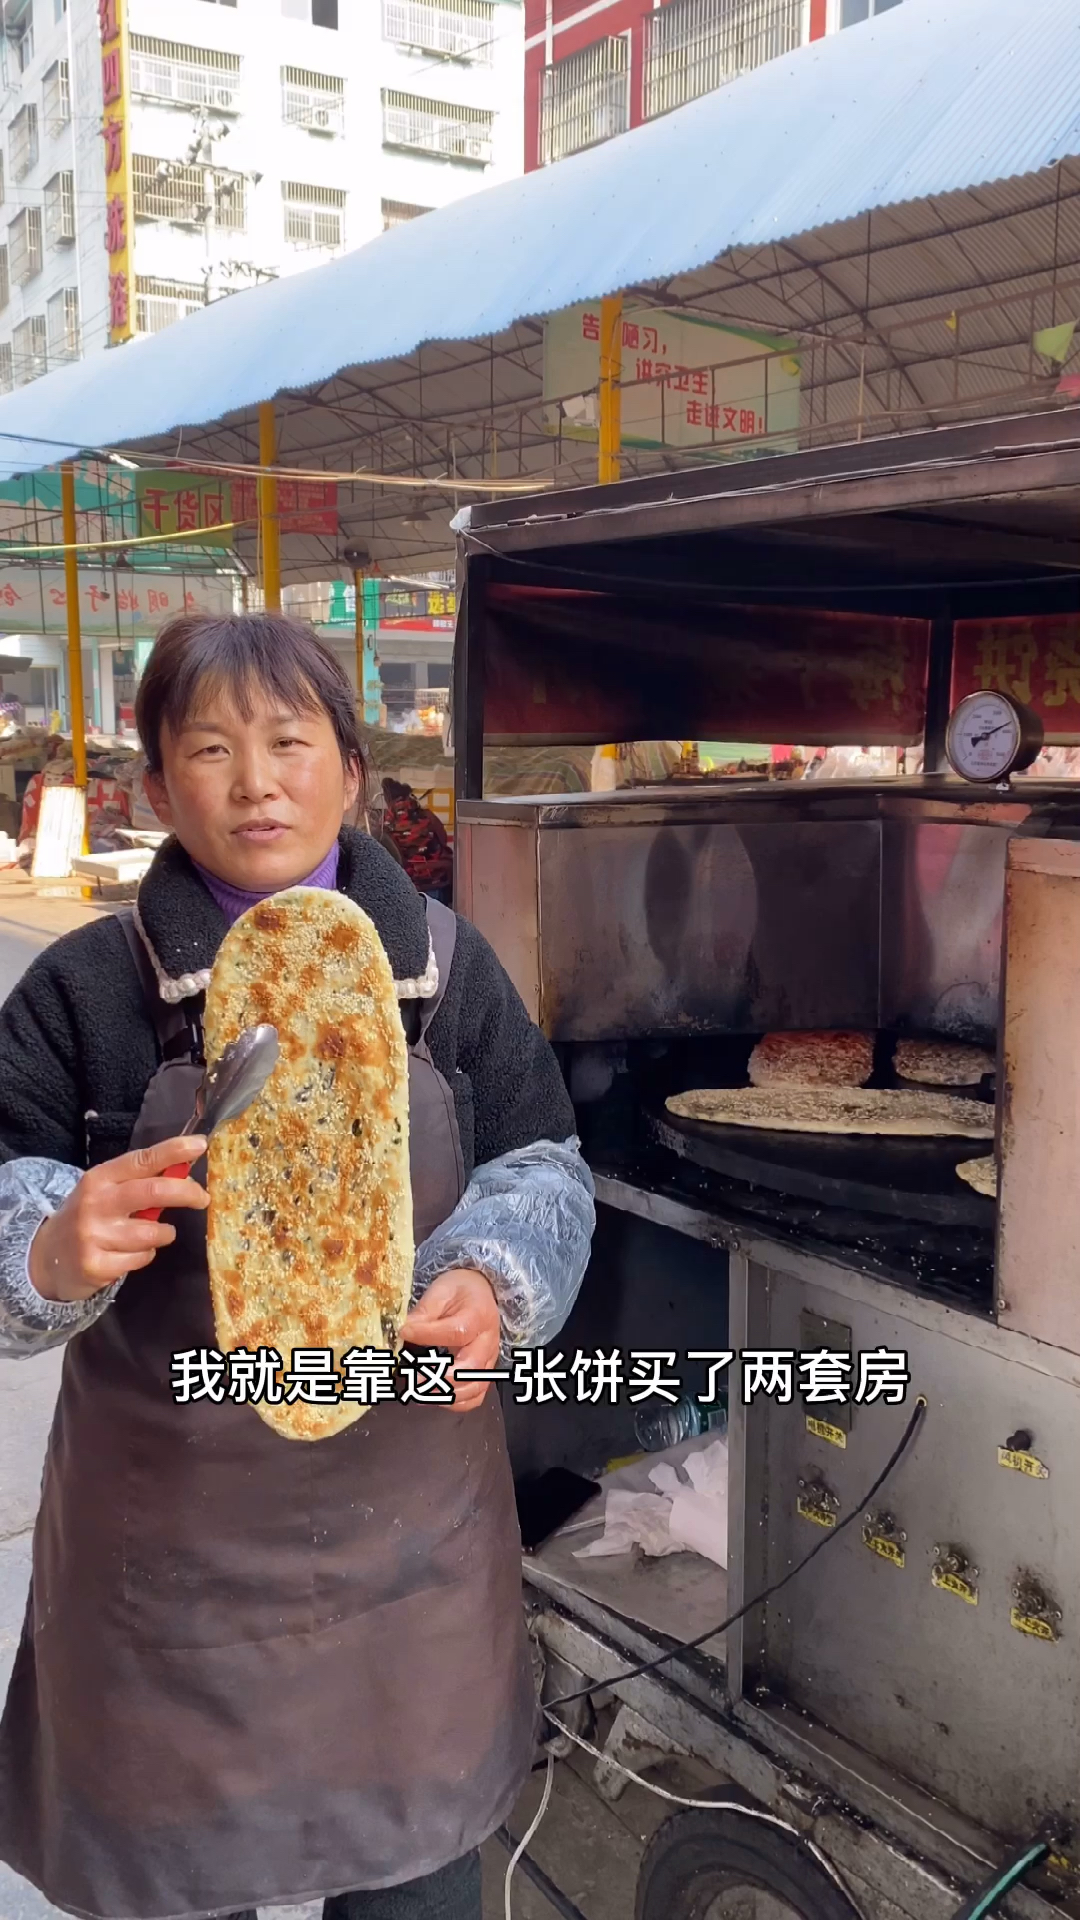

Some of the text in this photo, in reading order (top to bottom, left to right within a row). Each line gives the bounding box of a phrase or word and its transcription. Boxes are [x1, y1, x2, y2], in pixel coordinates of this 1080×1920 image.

[582, 313, 667, 355] 告陋习，
[143, 488, 225, 533] 干货区
